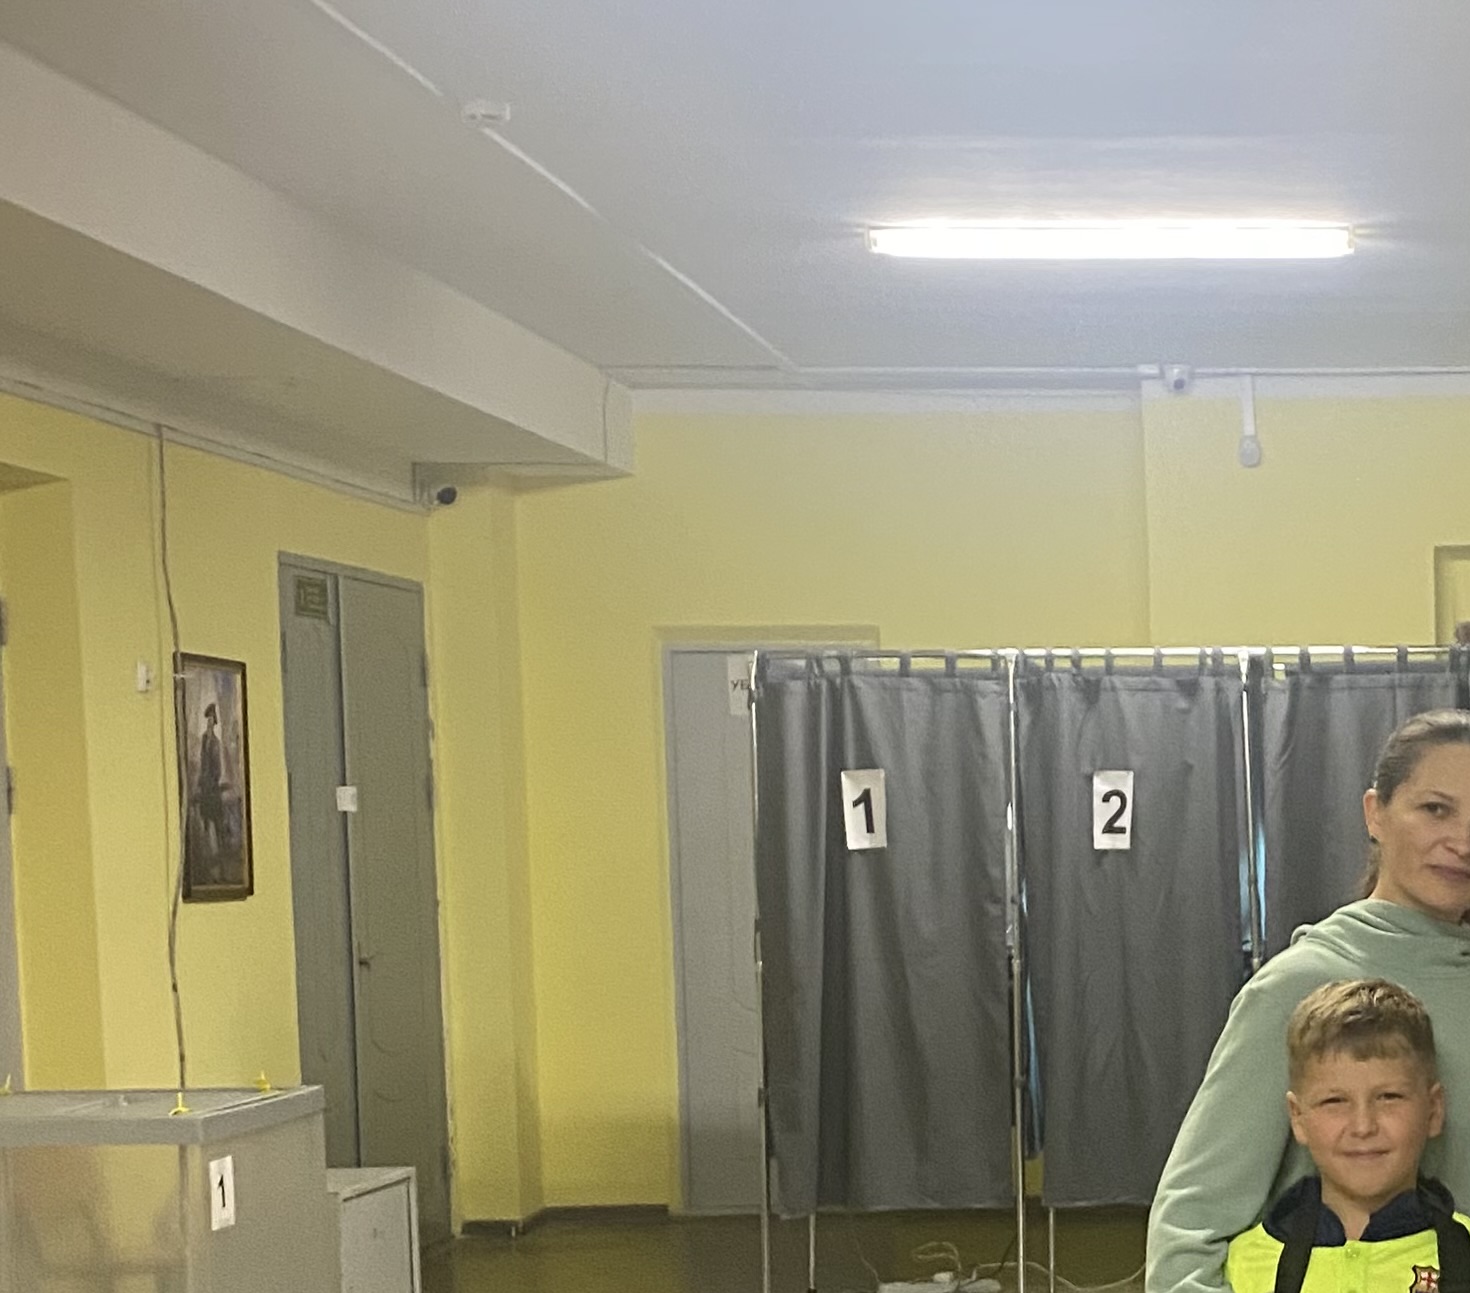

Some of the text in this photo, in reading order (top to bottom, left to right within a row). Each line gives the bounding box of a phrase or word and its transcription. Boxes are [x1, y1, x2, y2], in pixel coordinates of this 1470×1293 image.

[851, 788, 875, 834] 1
[1101, 789, 1128, 834] 2
[217, 1174, 226, 1208] 1
